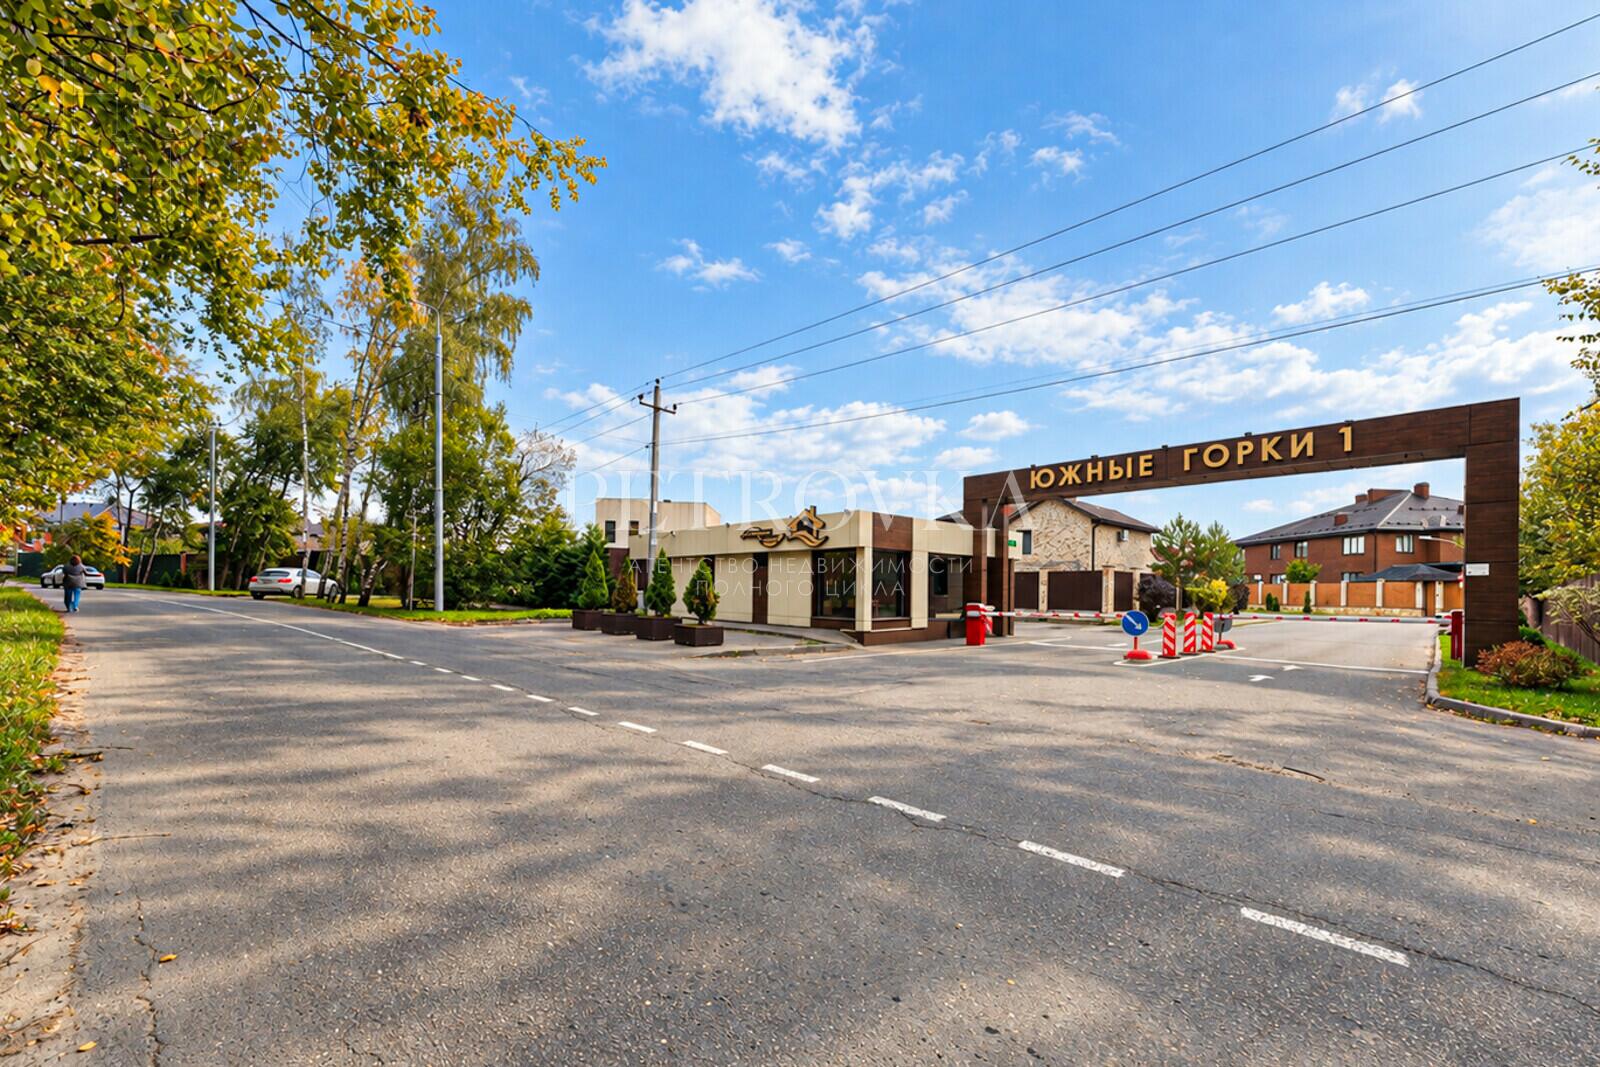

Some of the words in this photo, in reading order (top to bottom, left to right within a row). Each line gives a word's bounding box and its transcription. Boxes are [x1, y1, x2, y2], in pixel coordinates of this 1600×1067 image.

[1029, 454, 1154, 490] ЮЖНЫЕ
[1183, 431, 1314, 472] ГОРКИ
[1338, 425, 1353, 452] 1
